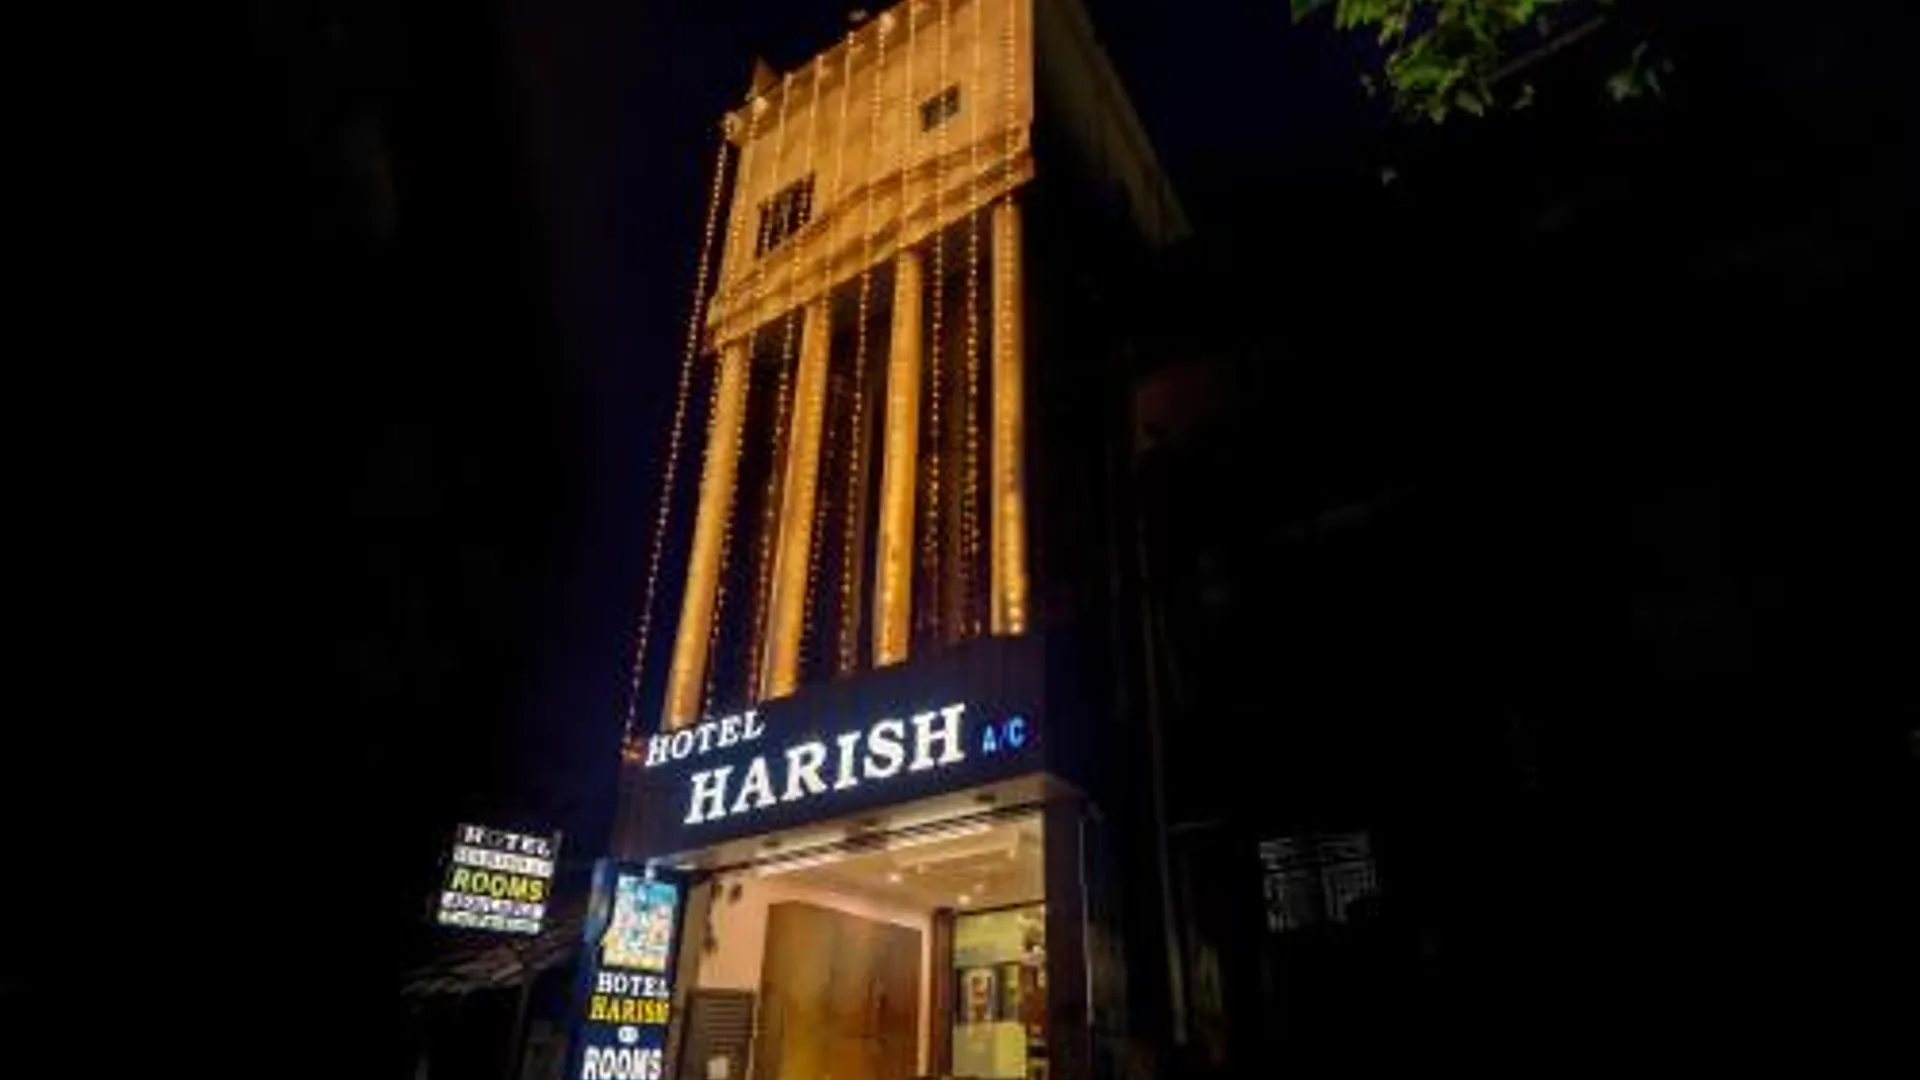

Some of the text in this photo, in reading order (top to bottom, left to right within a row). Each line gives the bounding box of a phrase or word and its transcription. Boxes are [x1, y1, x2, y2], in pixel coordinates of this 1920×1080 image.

[645, 709, 766, 767] HOTEL
[684, 703, 966, 825] HARISH
[451, 867, 543, 902] ROOMS
[596, 971, 669, 998] HOTEL
[582, 1044, 662, 1080] ROOMS
